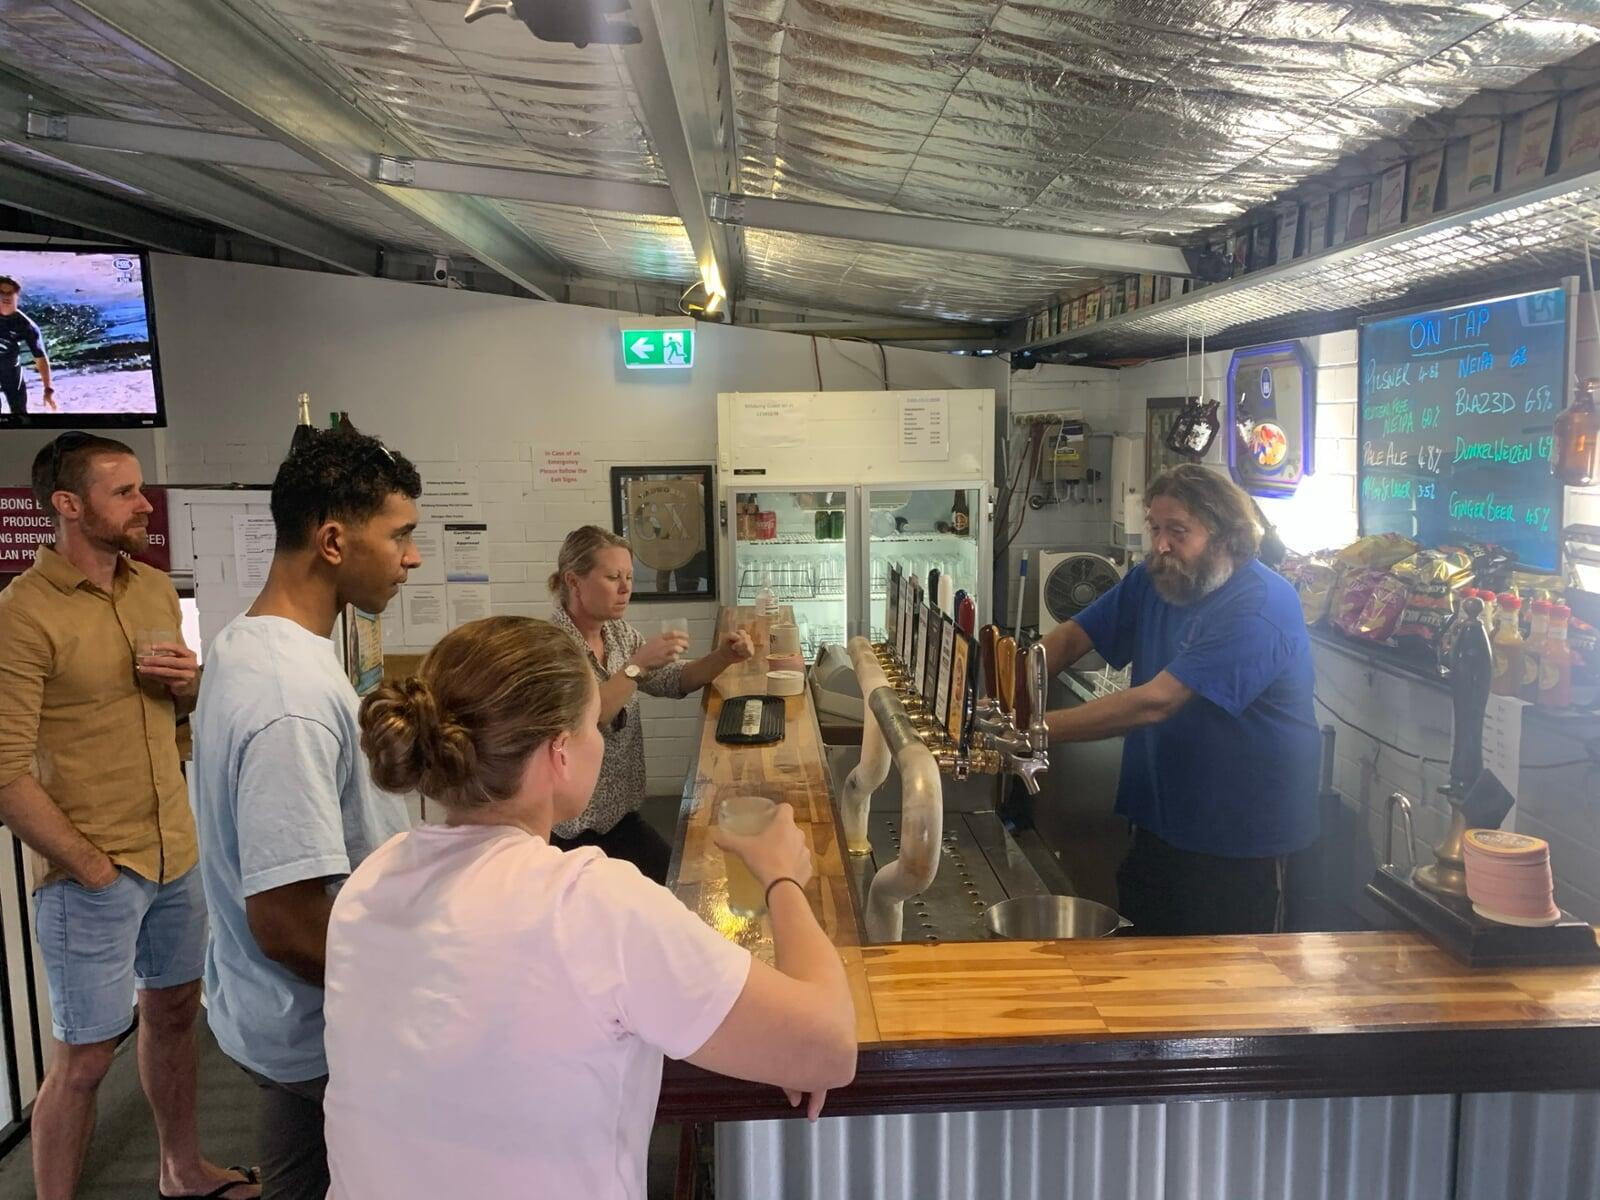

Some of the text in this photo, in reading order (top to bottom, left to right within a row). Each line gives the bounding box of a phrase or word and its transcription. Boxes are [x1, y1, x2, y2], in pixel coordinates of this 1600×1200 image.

[1410, 307, 1490, 350] ON TAP
[1365, 358, 1410, 395] PILSNER
[1458, 352, 1494, 378] NEIPA
[1363, 441, 1383, 466] PALE
[1386, 440, 1408, 466] ALE
[0, 498, 33, 510] BONG
[1449, 491, 1485, 520] GINGER
[1487, 491, 1516, 522] BEER
[2, 516, 52, 528] PRODUCE
[0, 532, 166, 547] NG BREWIN EE)
[21, 549, 37, 560] PR
